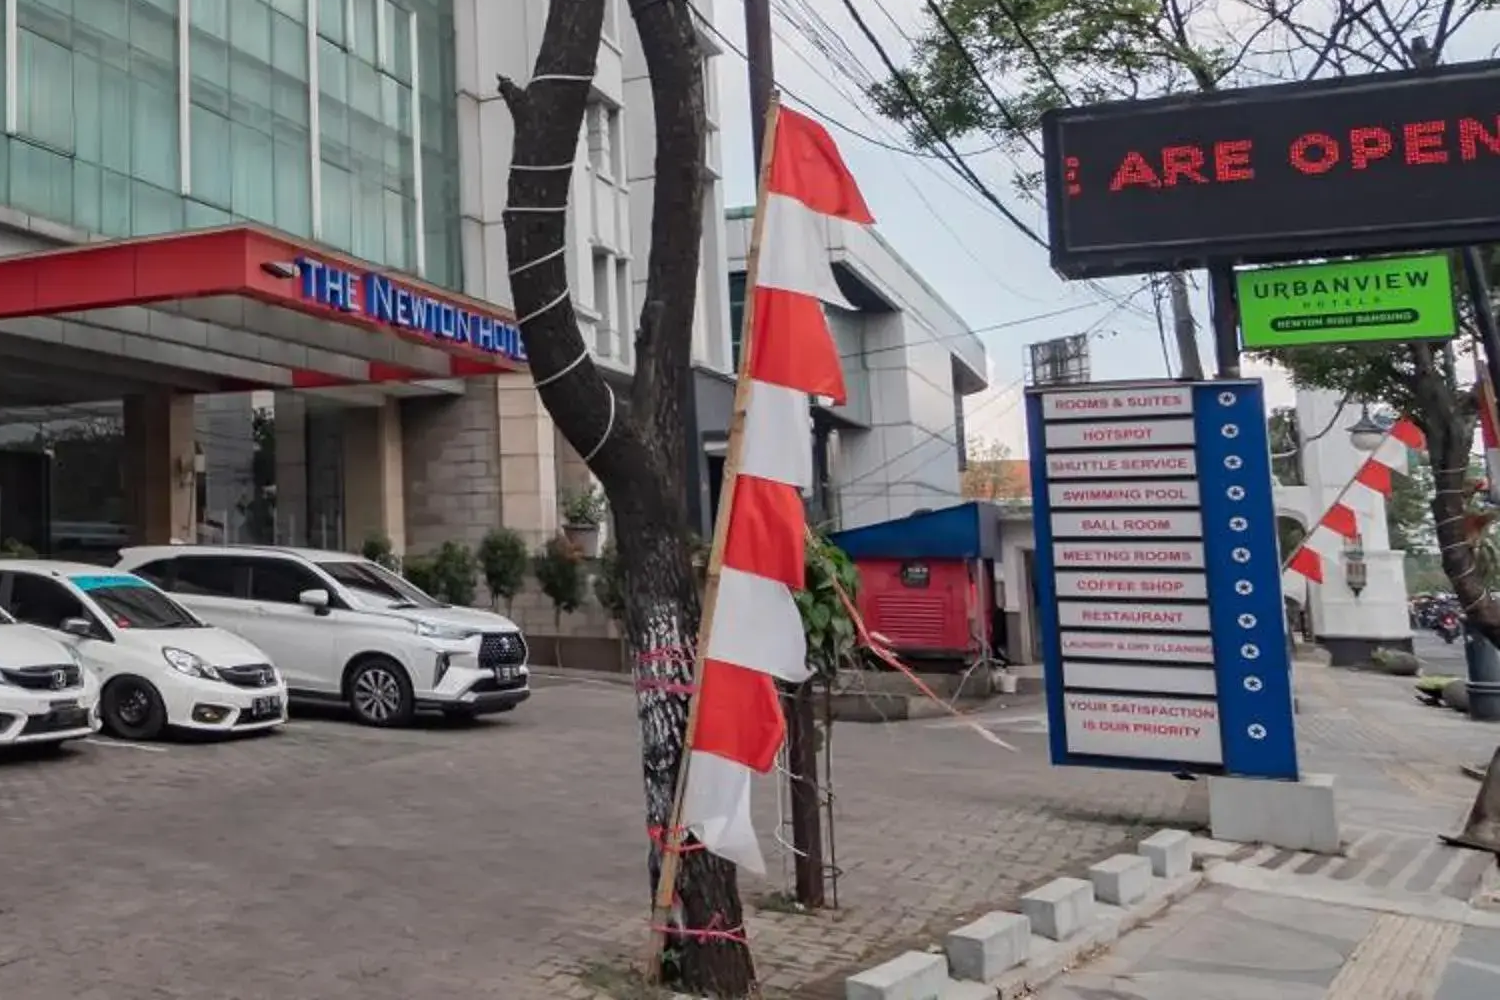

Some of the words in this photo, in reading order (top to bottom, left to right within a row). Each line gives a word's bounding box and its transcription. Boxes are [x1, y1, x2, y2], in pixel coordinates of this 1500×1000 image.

[1109, 139, 1255, 191] ARE
[1289, 113, 1500, 175] OPEN
[1253, 271, 1430, 300] URBANVIEW
[301, 258, 361, 311] THE
[368, 274, 471, 343] NEWTON
[477, 314, 529, 359] HOTE
[1276, 317, 1323, 329] NEWTON
[1055, 399, 1109, 409] ROOMS
[1113, 398, 1123, 408] &
[1128, 395, 1182, 407] SUITES
[1082, 428, 1153, 441] HOTSPOT
[1051, 459, 1117, 471] SHUTTLE
[1121, 457, 1188, 470] SERVICE
[1062, 490, 1141, 501] SWIMMING
[1145, 489, 1188, 500] POOL
[1081, 519, 1117, 531] BALL
[1123, 519, 1171, 530] ROOM
[1063, 551, 1130, 562] MEETING
[1135, 551, 1192, 562] ROOMS
[1076, 580, 1135, 591] COFFEE
[1140, 581, 1185, 592] SHOP
[1082, 610, 1184, 623] RESTAURANT
[1069, 700, 1108, 712] YOUR
[1111, 702, 1216, 719] SATISFACTION
[1082, 721, 1096, 730] IS
[1099, 722, 1130, 733] OUR
[1133, 723, 1201, 738] PRIORITY
